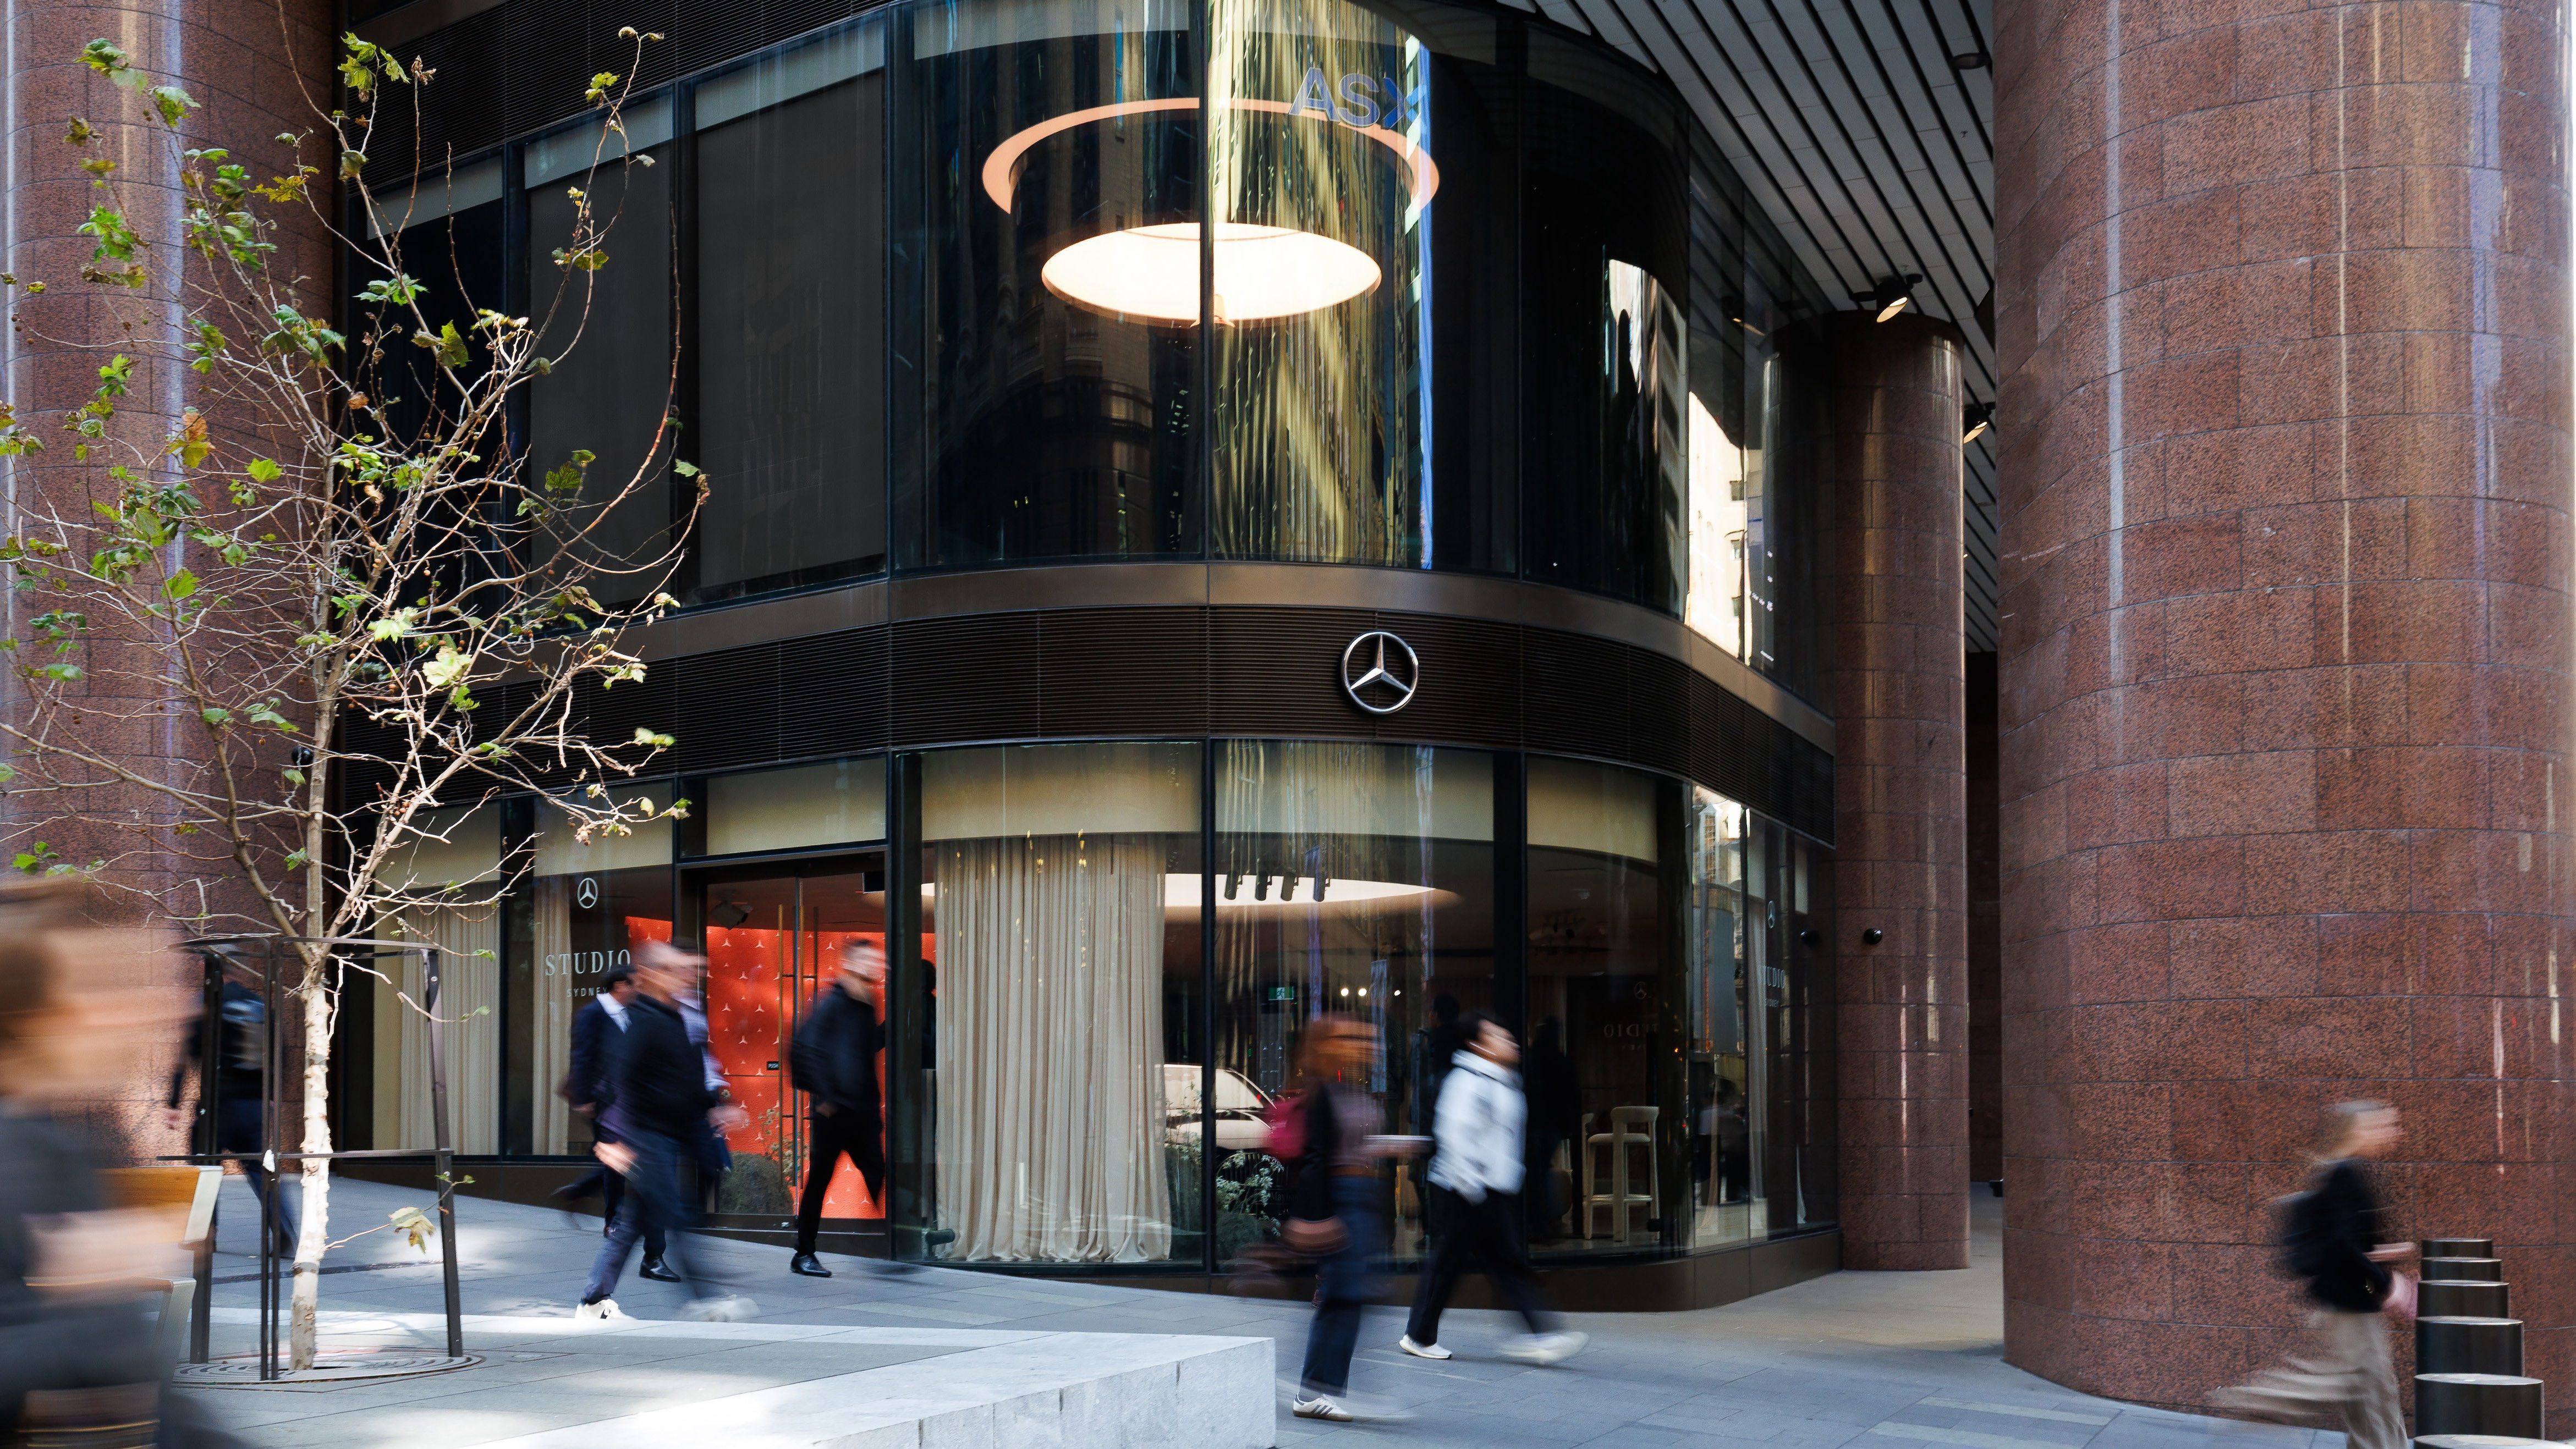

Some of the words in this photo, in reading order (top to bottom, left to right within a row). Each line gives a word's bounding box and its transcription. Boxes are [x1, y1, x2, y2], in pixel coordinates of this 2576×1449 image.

[1288, 67, 1427, 130] ASX
[545, 949, 631, 976] STUDIO
[566, 987, 607, 998] SYDNEY
